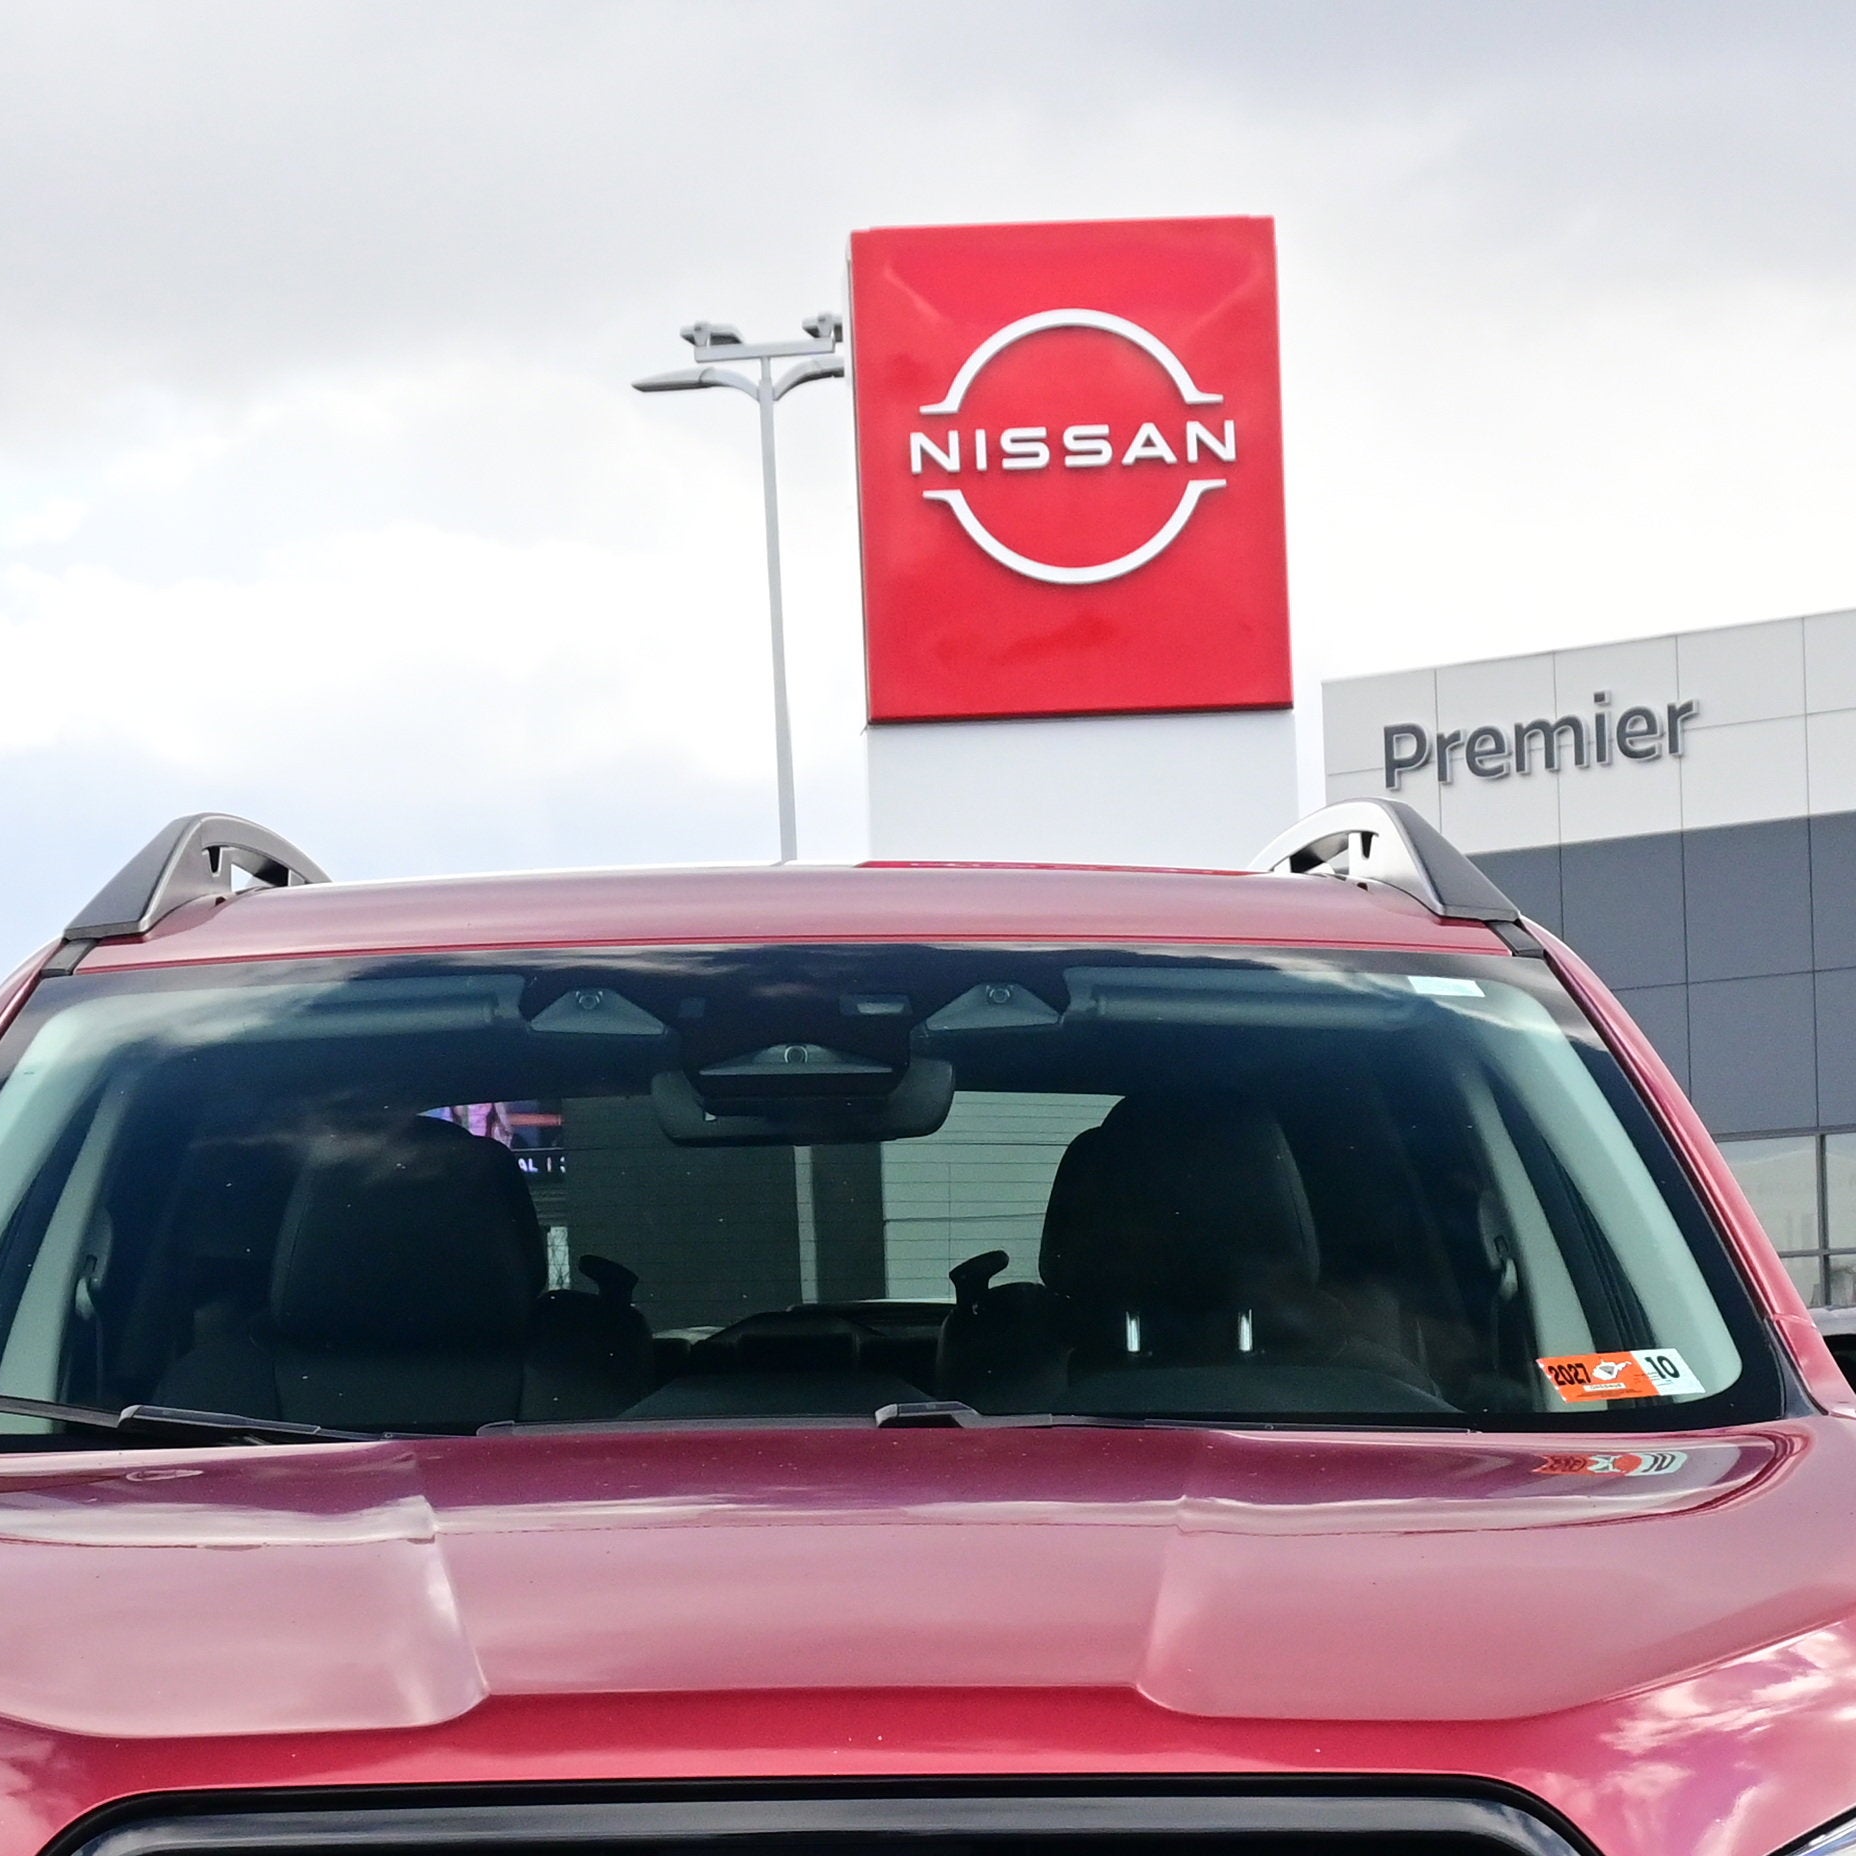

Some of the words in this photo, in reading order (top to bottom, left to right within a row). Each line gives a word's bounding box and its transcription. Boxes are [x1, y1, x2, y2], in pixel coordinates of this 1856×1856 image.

[909, 419, 1238, 475] NISSAN
[1382, 688, 1700, 792] Premier
[1547, 1363, 1592, 1387] 2027
[1644, 1355, 1681, 1380] 10
